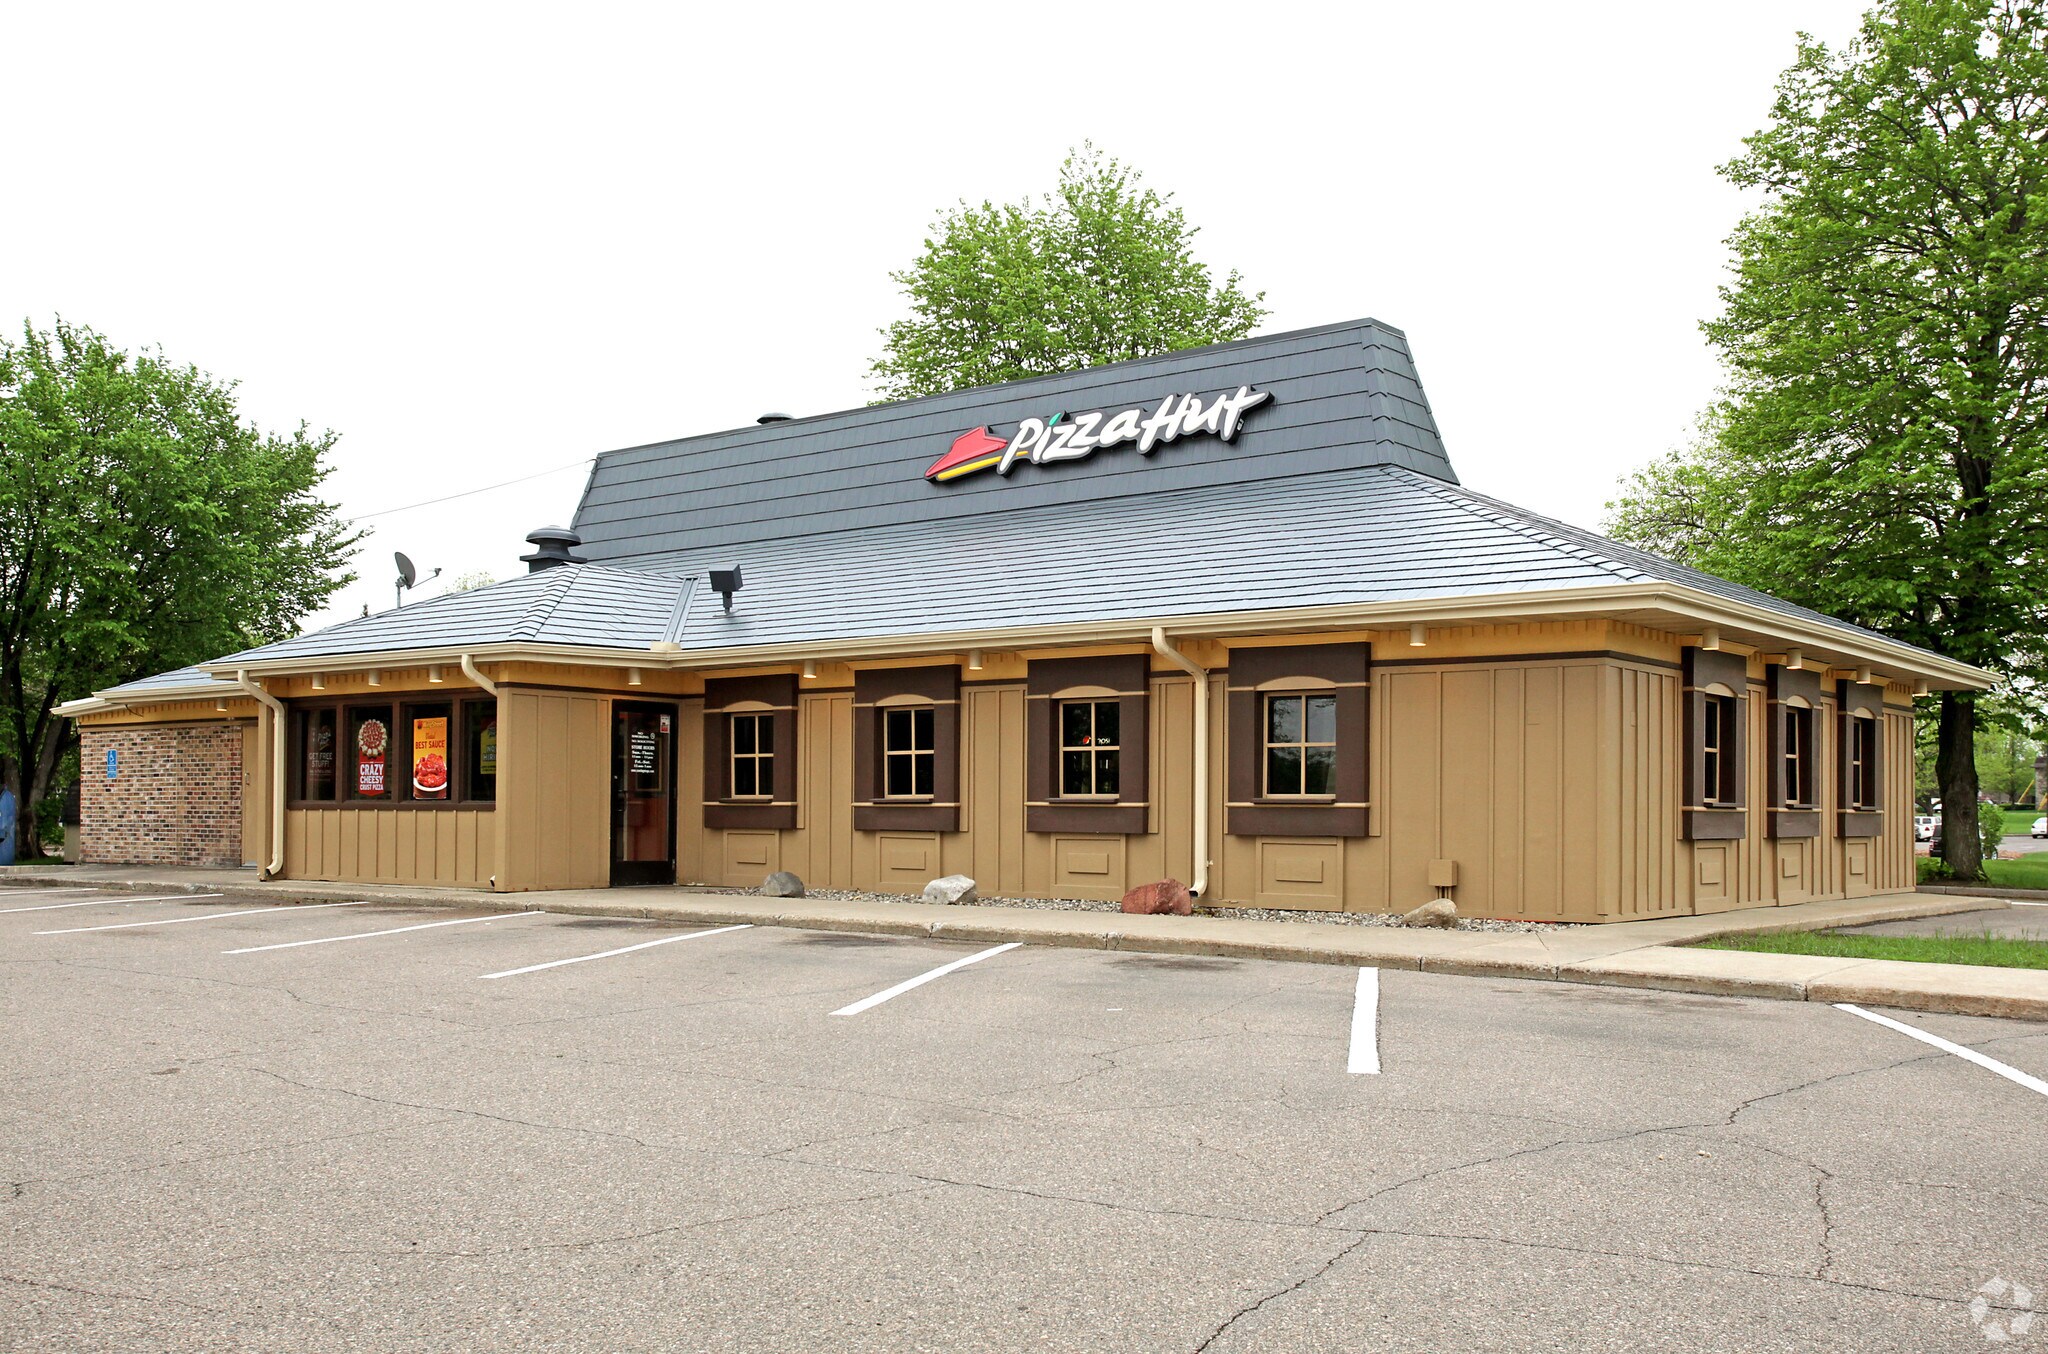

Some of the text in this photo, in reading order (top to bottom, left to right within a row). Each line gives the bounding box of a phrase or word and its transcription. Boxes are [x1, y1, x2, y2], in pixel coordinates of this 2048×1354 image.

[998, 385, 1270, 474] Pizza Hut
[415, 739, 445, 749] BEST SAUCE
[309, 752, 333, 760] GET FREE
[360, 764, 384, 776] CRAZY
[360, 775, 384, 784] CHEESY
